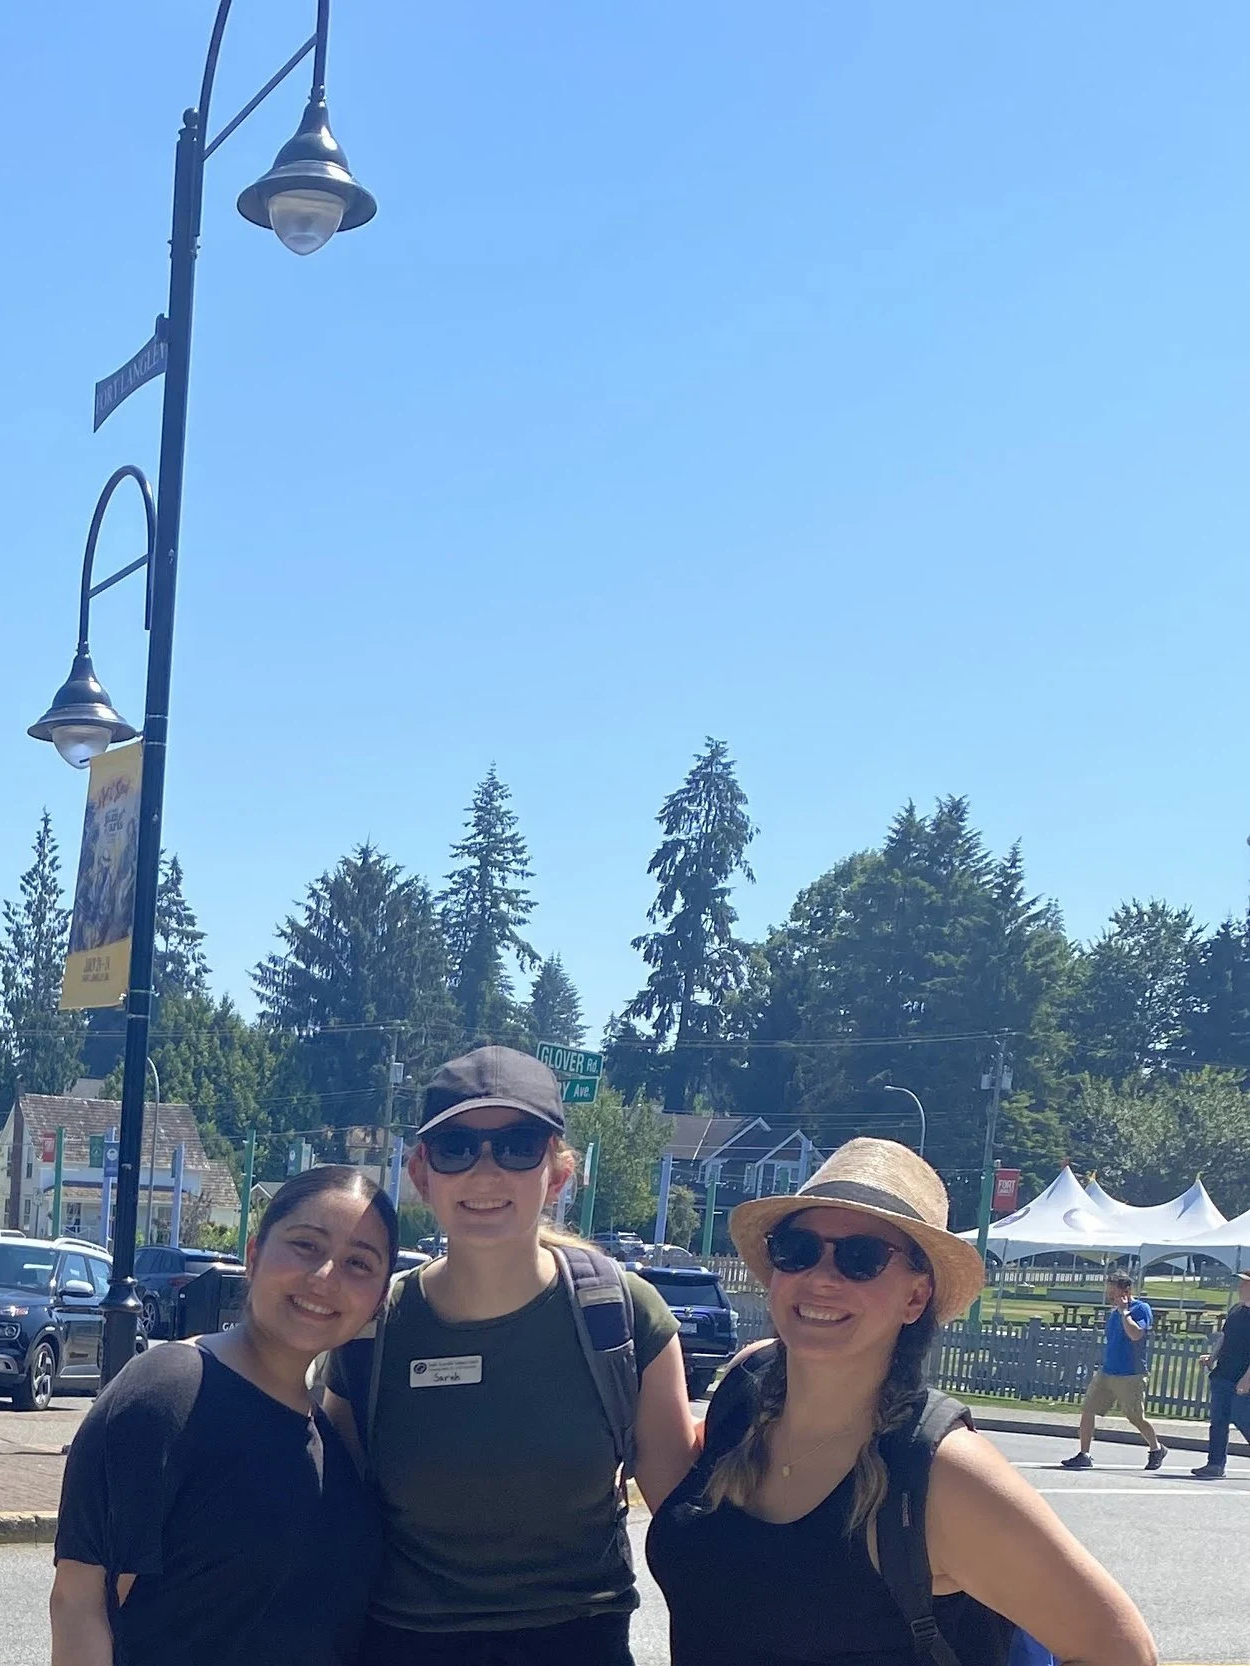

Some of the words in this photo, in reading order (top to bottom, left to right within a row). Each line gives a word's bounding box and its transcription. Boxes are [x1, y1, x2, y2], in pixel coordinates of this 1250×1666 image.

[540, 1046, 585, 1073] GLOVER
[586, 1058, 598, 1072] Rd.
[573, 1083, 590, 1097] Ave.
[433, 1372, 461, 1382] Sarah
